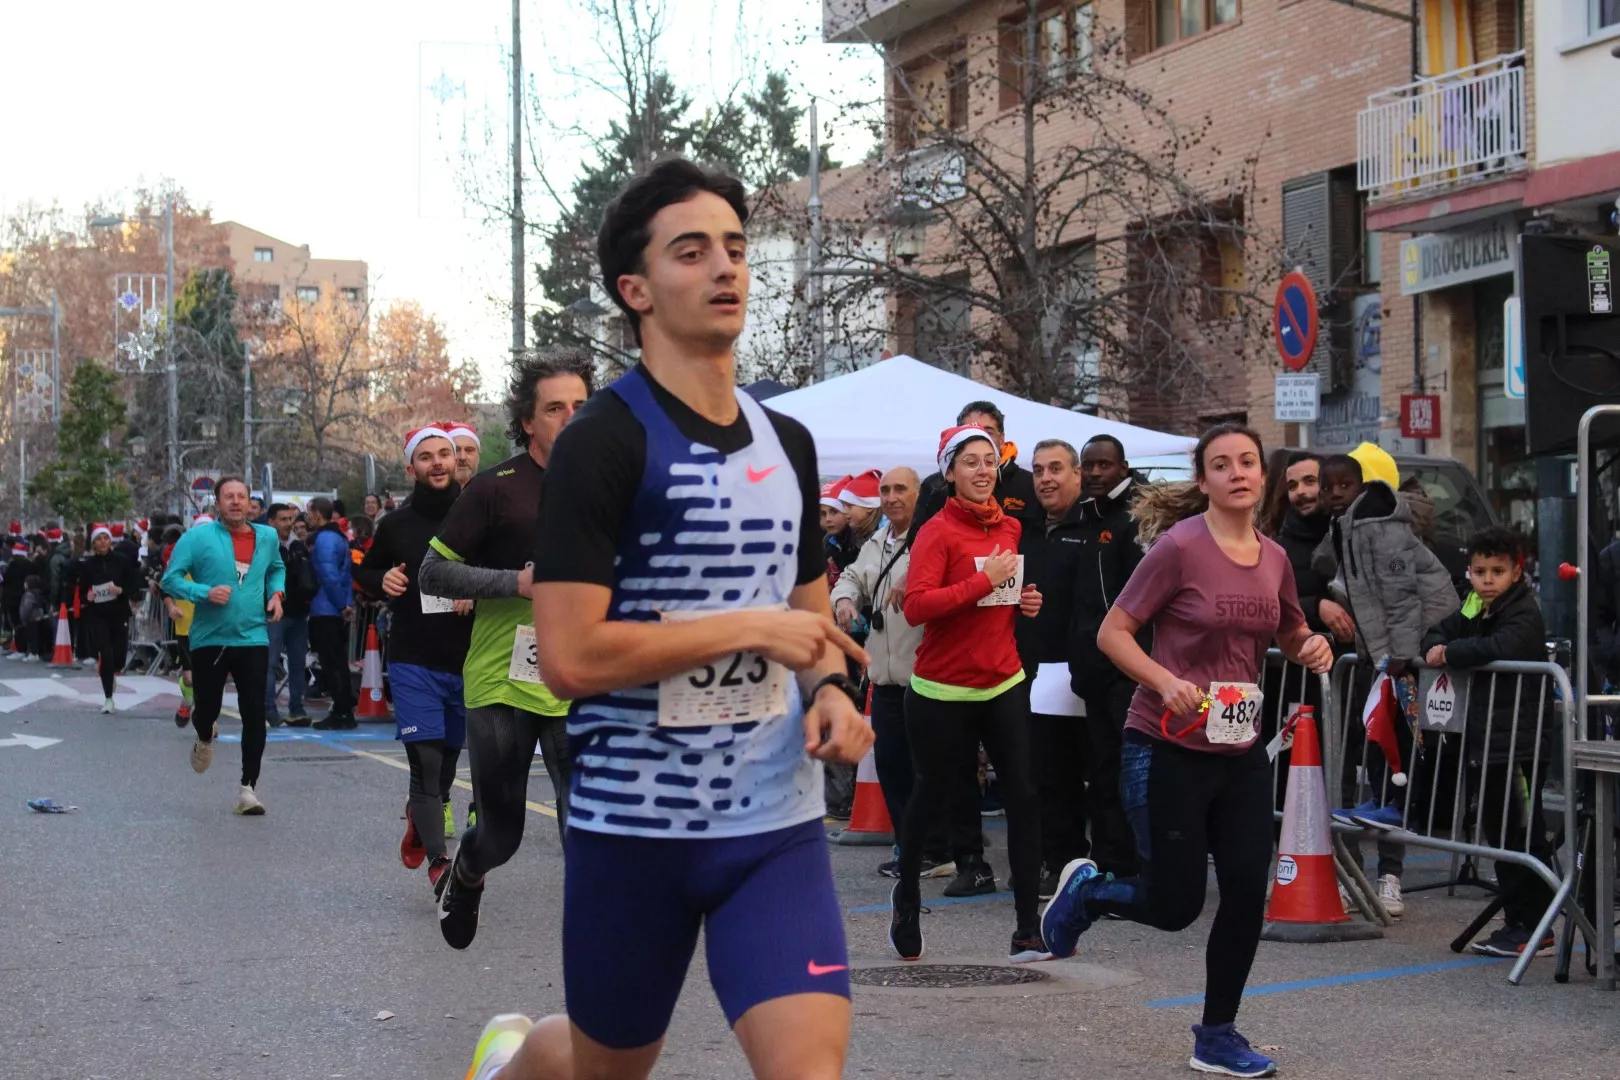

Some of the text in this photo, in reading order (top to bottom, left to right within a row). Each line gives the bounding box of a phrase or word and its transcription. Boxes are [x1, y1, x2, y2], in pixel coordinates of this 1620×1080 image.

[1421, 223, 1509, 279] DROGUERÍA
[1215, 600, 1278, 622] STRONG
[1221, 701, 1256, 724] 483
[1427, 699, 1452, 712] ALCO
[1278, 863, 1295, 875] bnf
